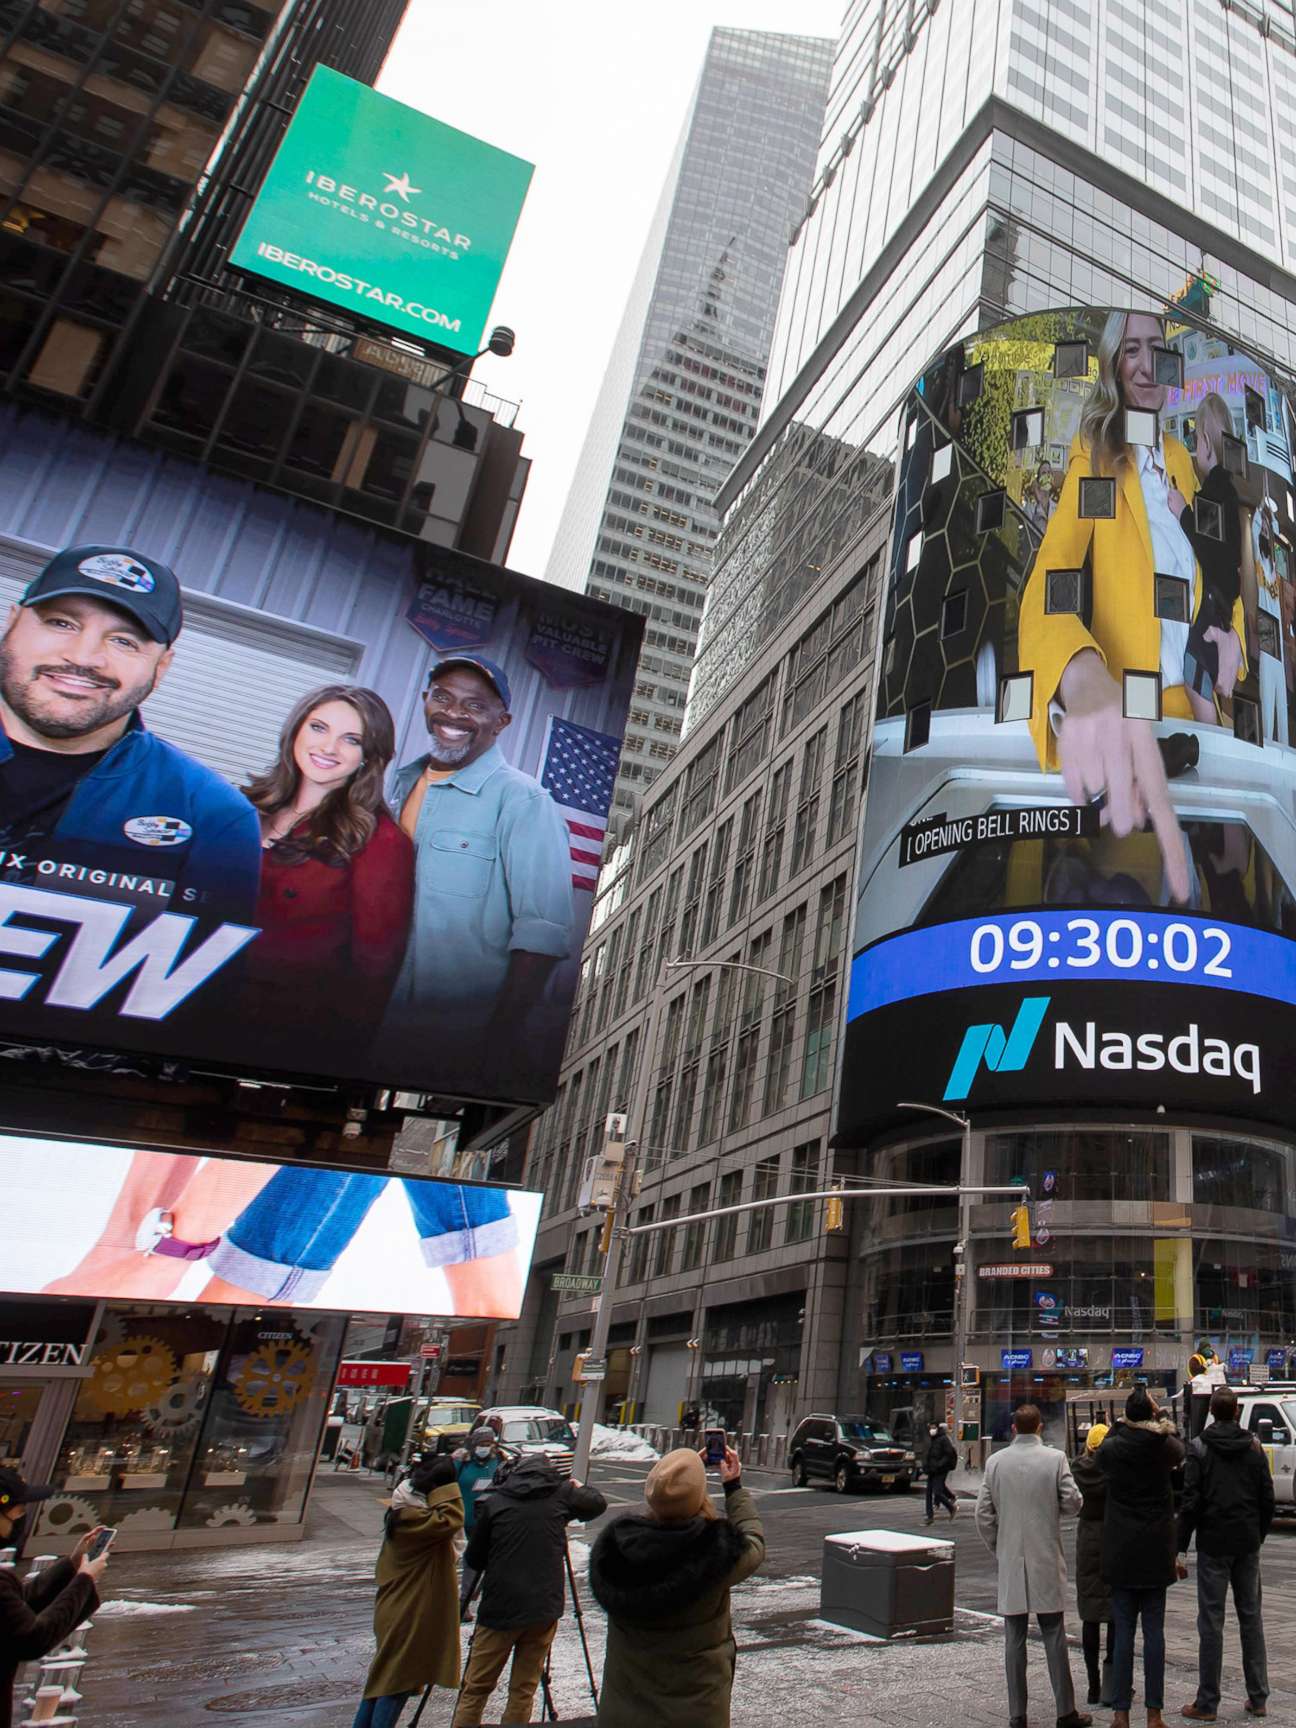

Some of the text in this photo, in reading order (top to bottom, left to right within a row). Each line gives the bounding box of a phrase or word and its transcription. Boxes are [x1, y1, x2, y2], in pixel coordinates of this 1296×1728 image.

[305, 170, 472, 251] IBEROSTAR
[308, 191, 460, 261] HOTELS & RESORTS
[256, 242, 462, 333] IBEROSTAR.COM
[417, 583, 495, 623] FAME
[532, 634, 606, 666] PIT CREW
[536, 624, 609, 655] VALUABLE
[915, 820, 974, 856] OPENING
[977, 813, 1015, 840] BELL
[1018, 809, 1071, 834] RINGS
[38, 860, 173, 897] ORIGINAL
[970, 918, 1233, 978] 09:30:02
[1054, 1021, 1262, 1095] Nasdaq
[553, 1276, 599, 1289] BROADWAY
[979, 1264, 1051, 1277] BRANDED CITIES
[1064, 1305, 1110, 1319] Nasdaq
[257, 1331, 293, 1340] CITIZEN
